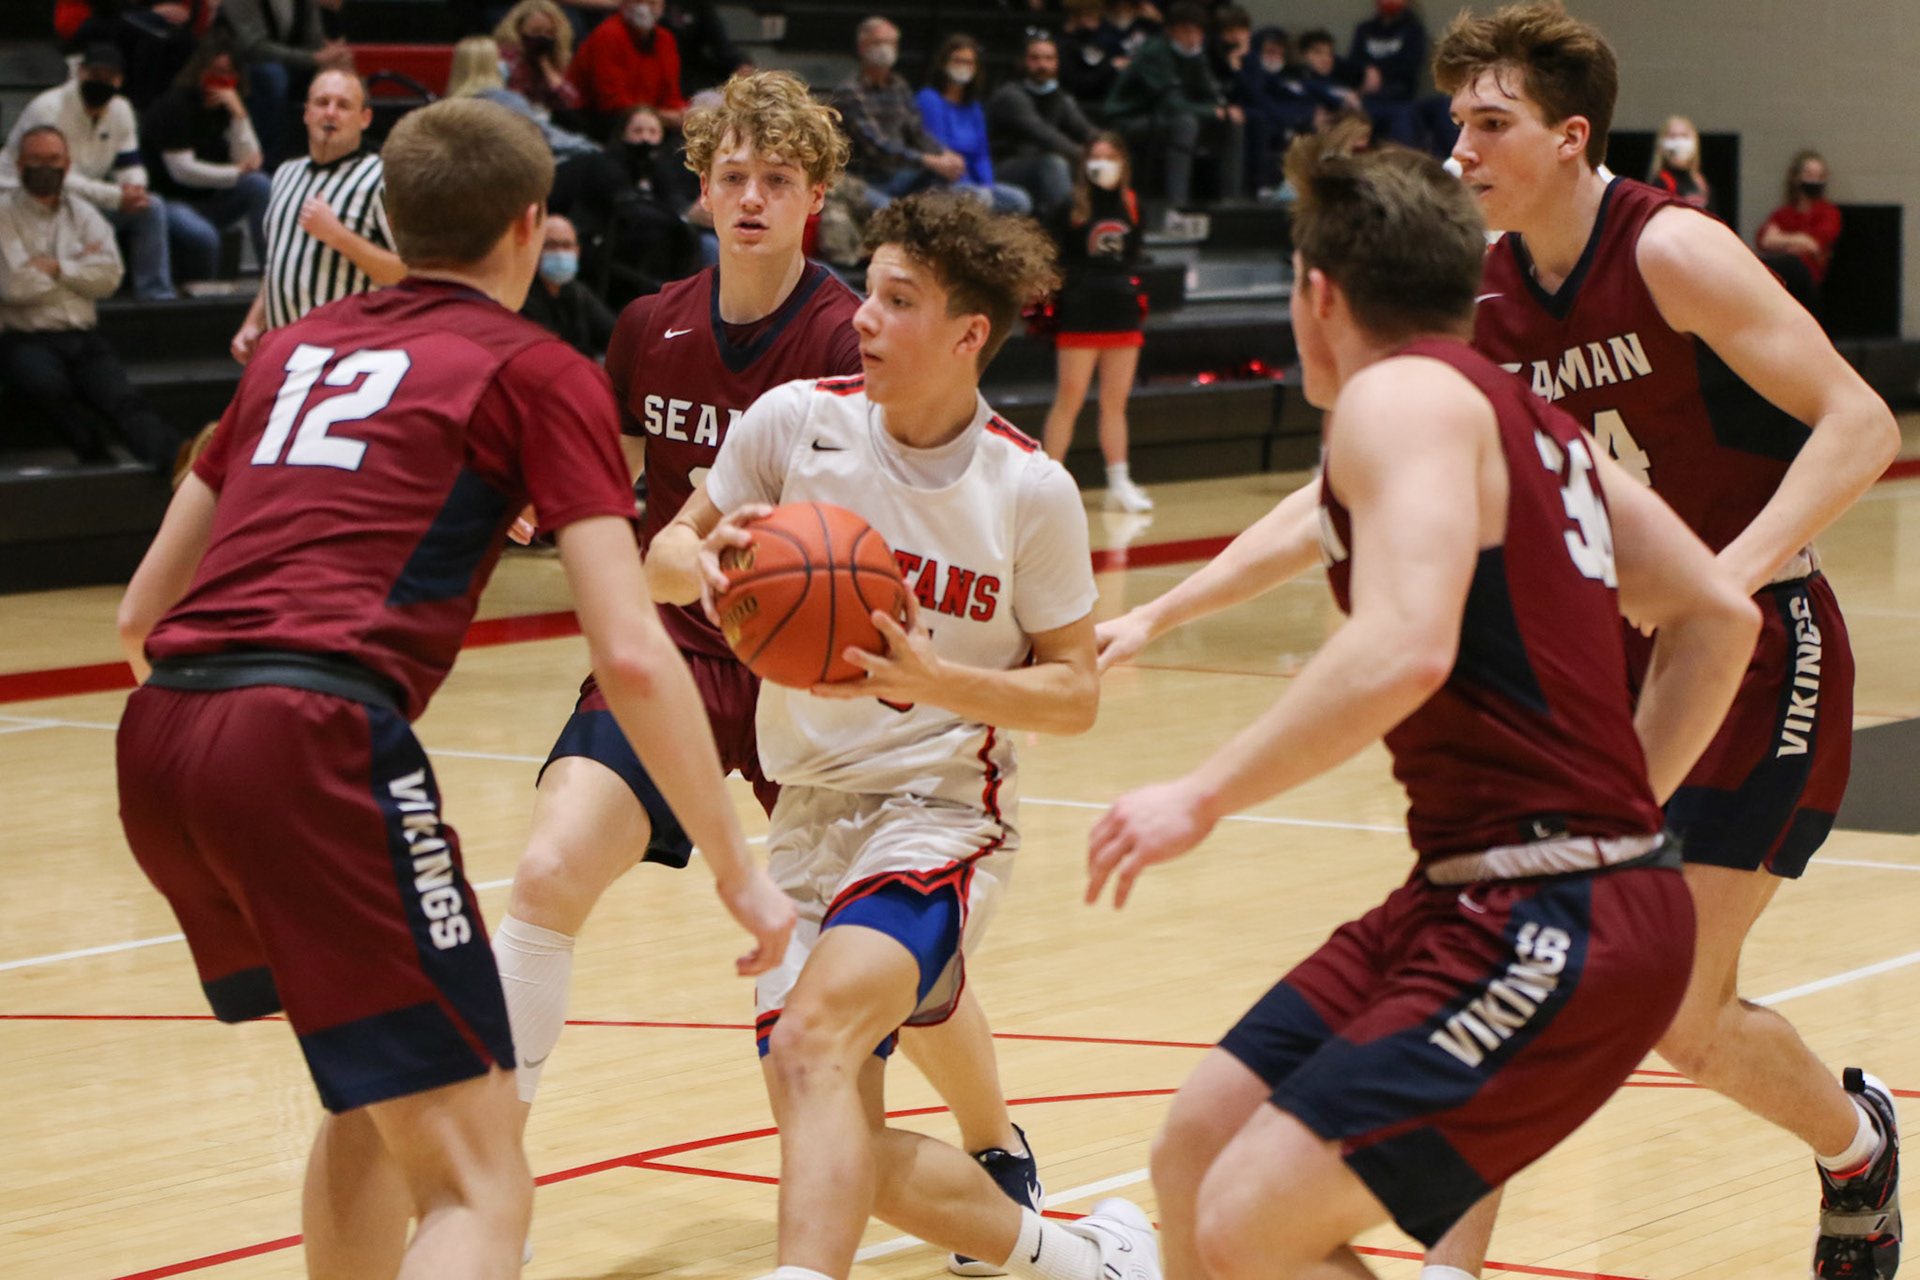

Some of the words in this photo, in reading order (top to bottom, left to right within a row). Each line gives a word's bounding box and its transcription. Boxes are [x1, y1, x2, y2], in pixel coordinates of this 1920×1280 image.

[250, 343, 412, 472] 12
[644, 394, 743, 447] SEA
[1498, 332, 1653, 404] AMAN
[1776, 596, 1822, 759] VIKINGS
[388, 766, 472, 950] VIKINGS
